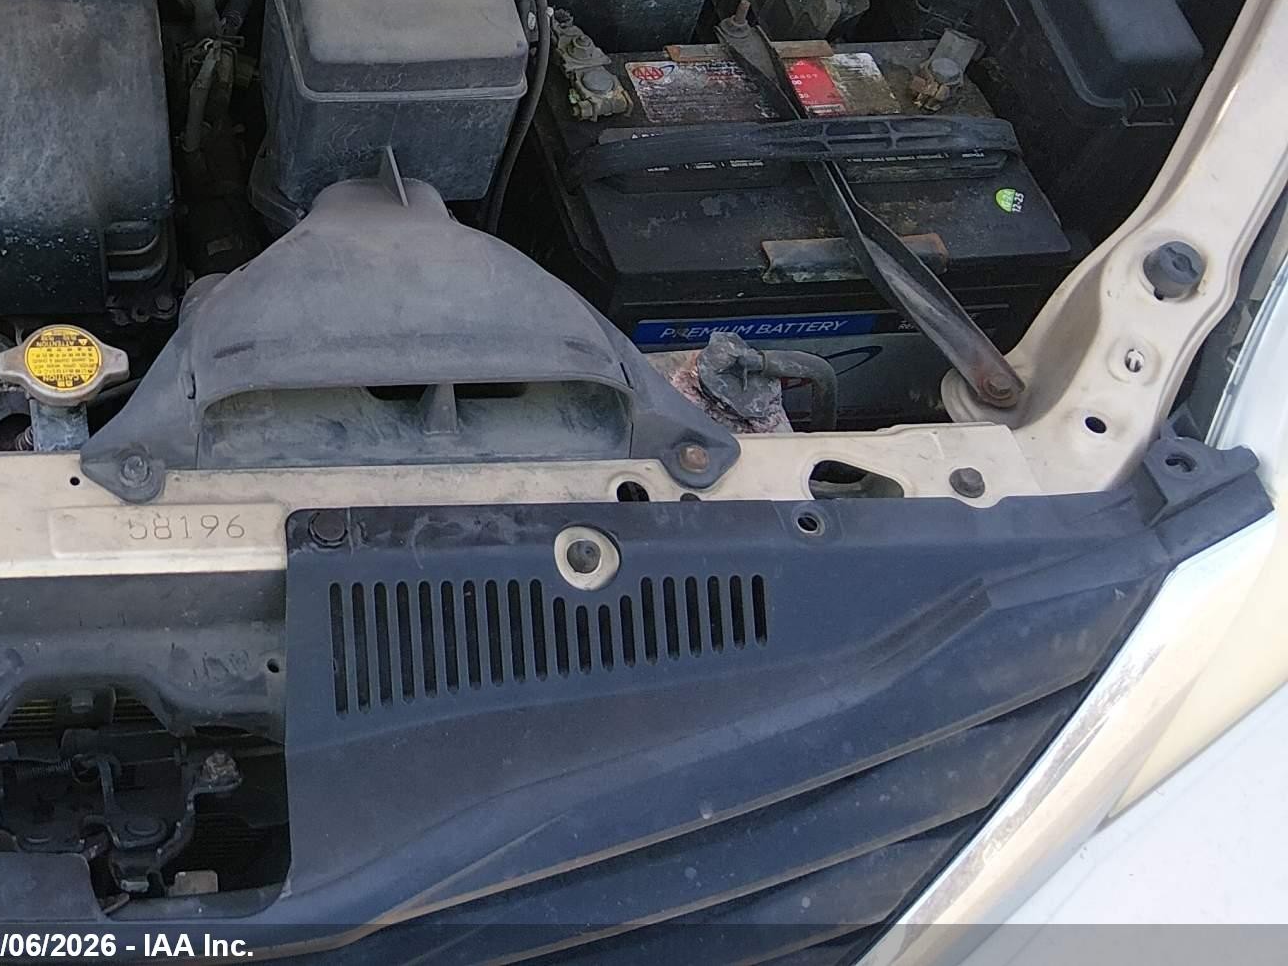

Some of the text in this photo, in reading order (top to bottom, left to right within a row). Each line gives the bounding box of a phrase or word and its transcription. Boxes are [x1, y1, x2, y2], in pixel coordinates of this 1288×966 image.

[635, 66, 661, 80] AAA
[659, 320, 849, 339] PREMIUM BATTERY
[42, 374, 80, 382] CAUTION
[128, 513, 245, 540] 58196
